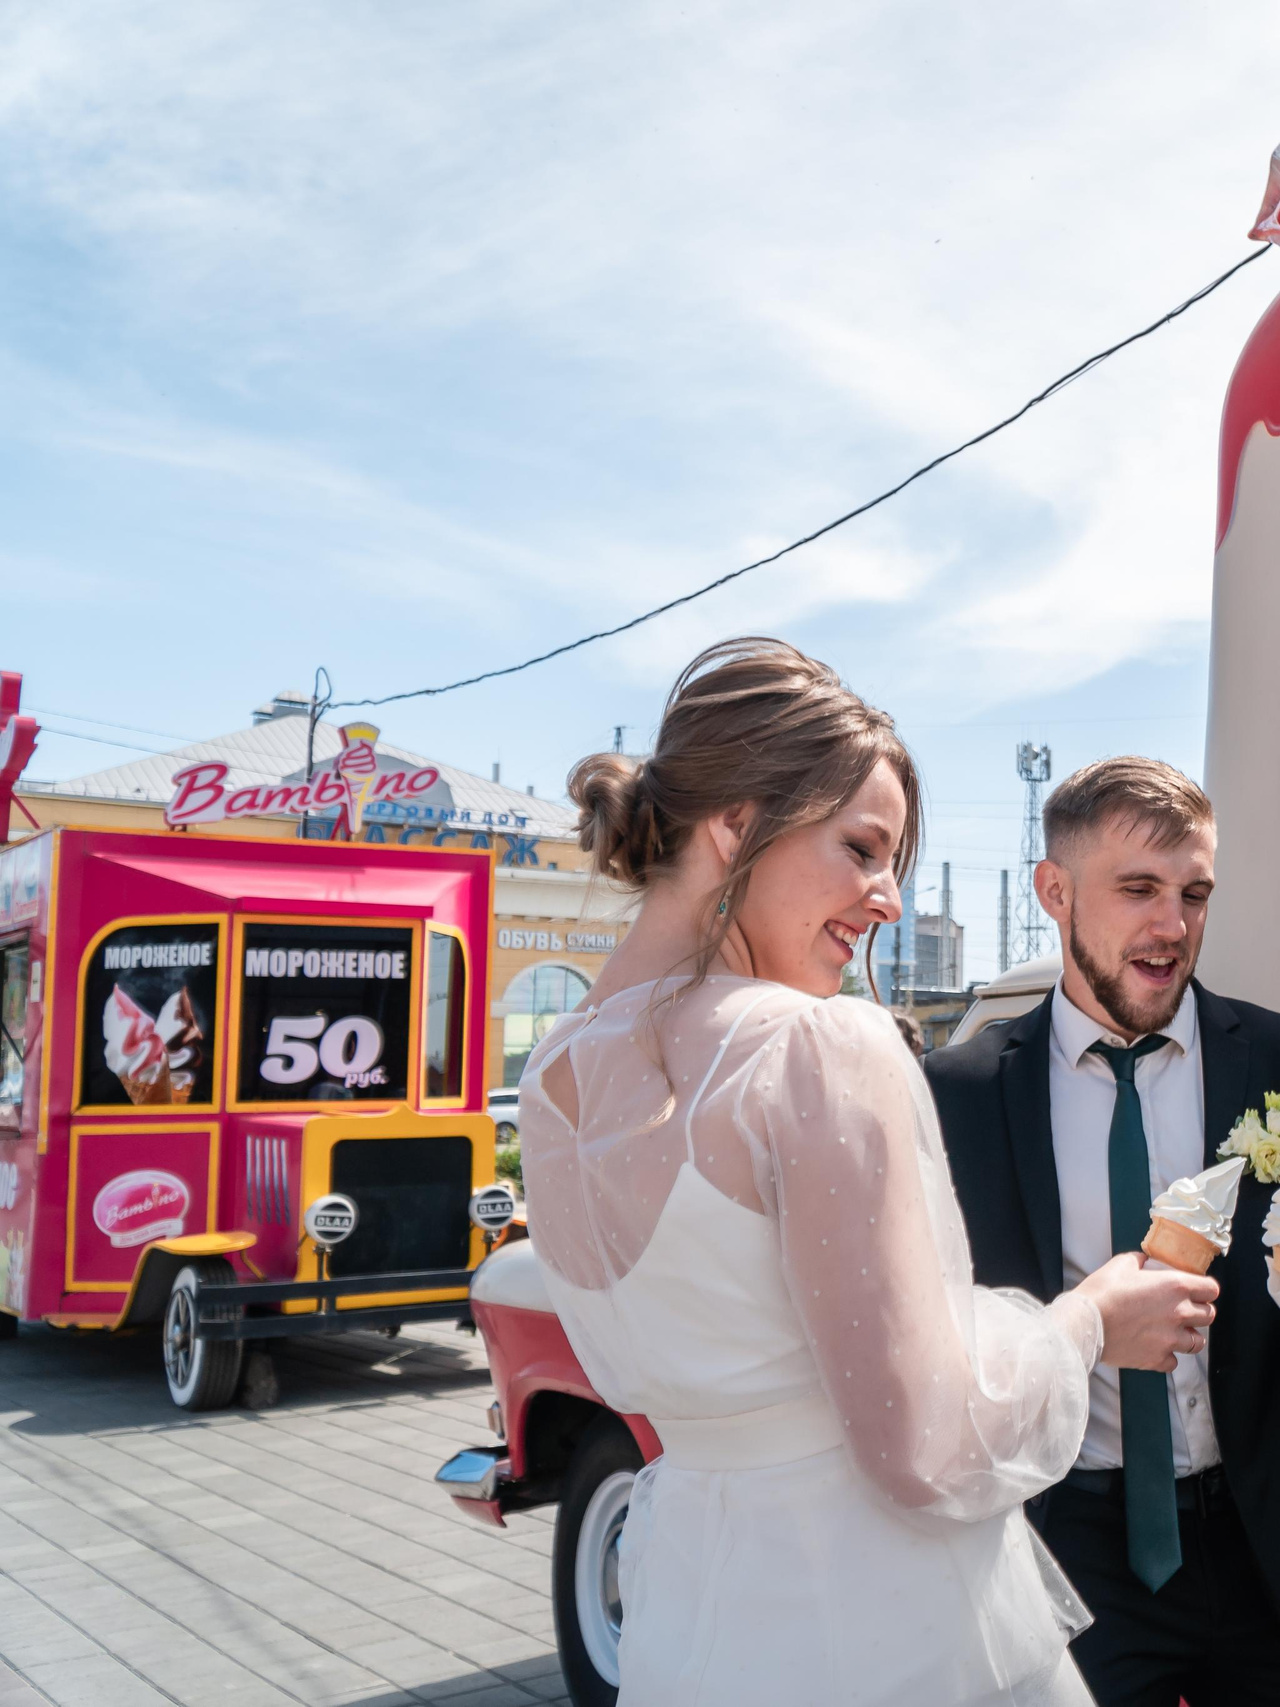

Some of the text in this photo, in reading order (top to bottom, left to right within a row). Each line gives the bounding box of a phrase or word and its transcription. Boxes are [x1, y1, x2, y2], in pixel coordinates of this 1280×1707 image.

[498, 929, 563, 952] ОБУВЬ
[104, 943, 212, 970] МОРОЖЕНОЕ
[245, 950, 406, 979] МОРОЖЕНОЕ
[259, 1014, 384, 1085] 50
[344, 1069, 388, 1089] руб.
[478, 1202, 513, 1214] DLAA
[316, 1216, 351, 1228] DLAA
